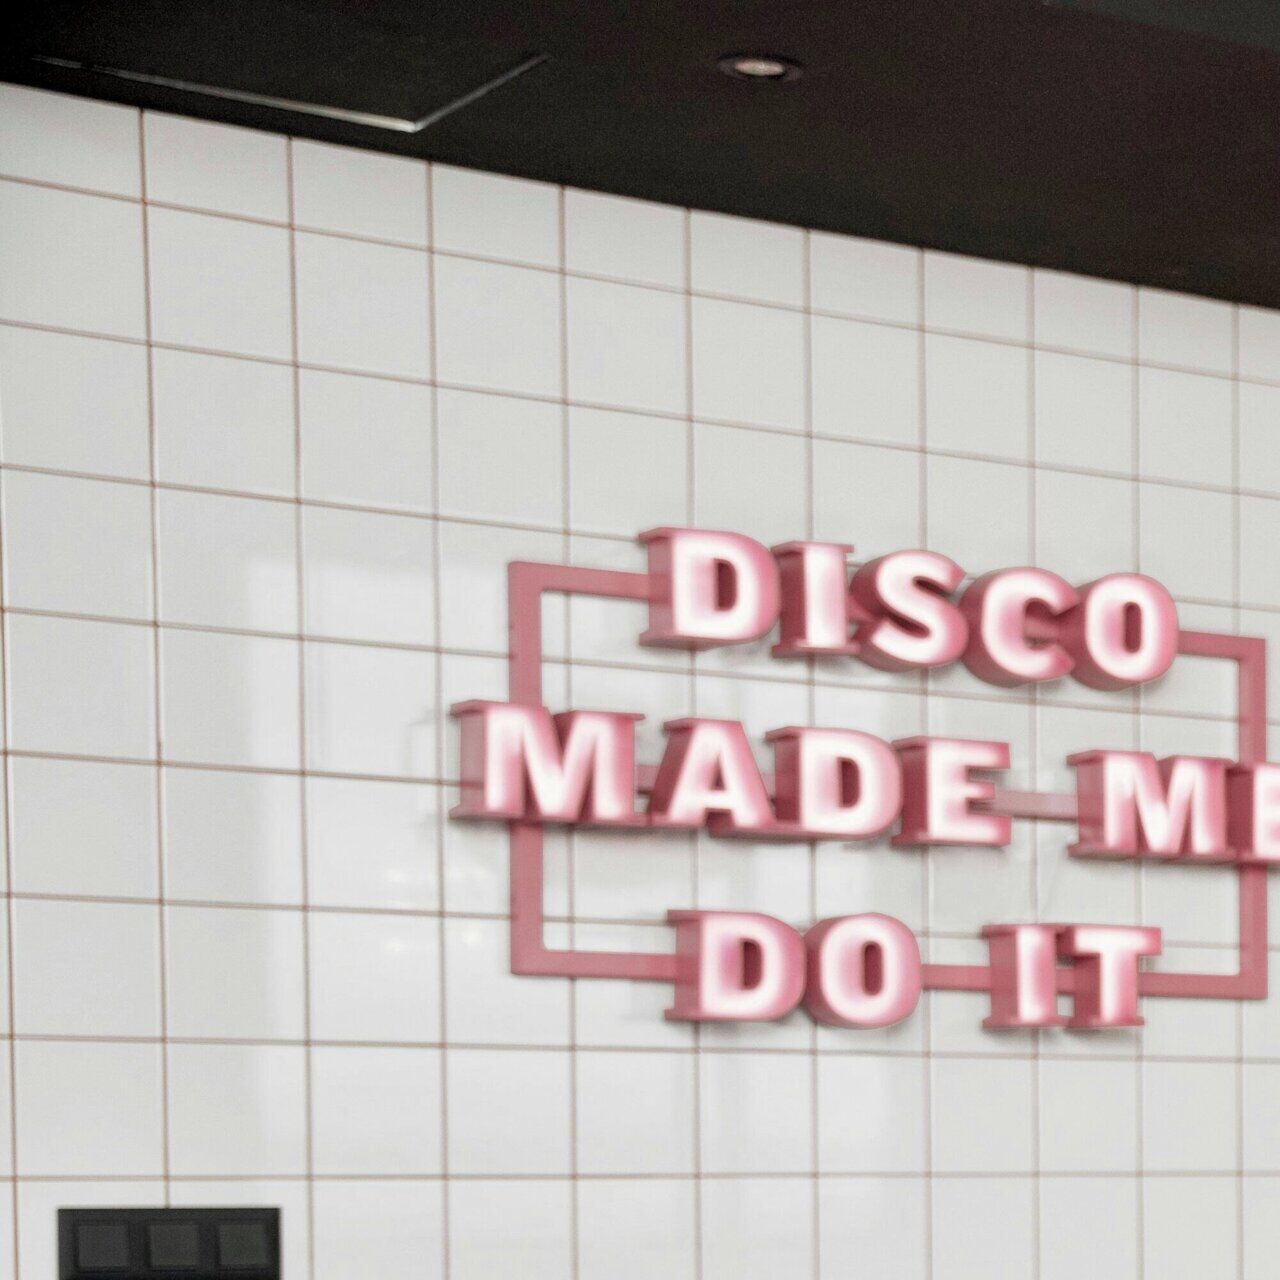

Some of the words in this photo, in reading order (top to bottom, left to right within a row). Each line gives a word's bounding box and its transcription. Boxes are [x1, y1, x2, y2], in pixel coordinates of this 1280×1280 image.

[638, 527, 1180, 691] DISCO
[449, 699, 1012, 847] MADE
[663, 908, 921, 1029] DO
[982, 924, 1162, 1029] IT
